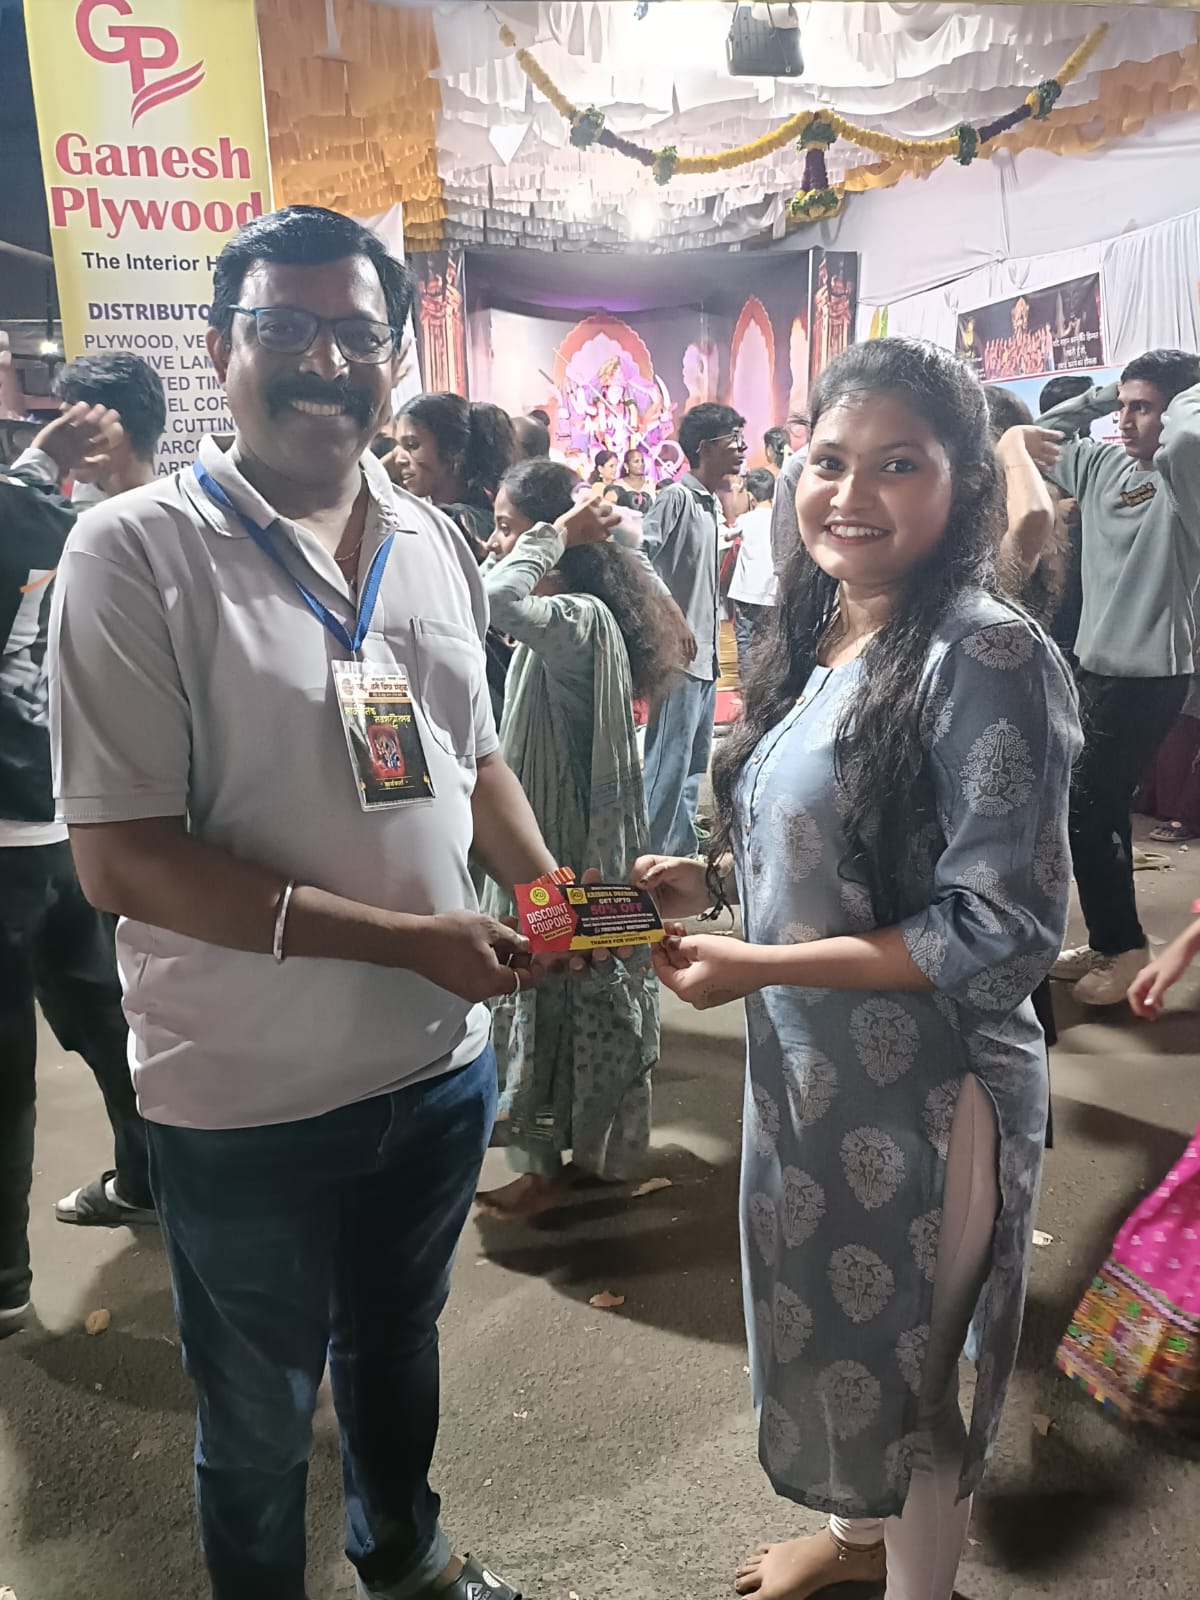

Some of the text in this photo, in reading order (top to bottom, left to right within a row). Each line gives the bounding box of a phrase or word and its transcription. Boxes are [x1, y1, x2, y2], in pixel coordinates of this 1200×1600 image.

[55, 132, 251, 179] Ganesh
[50, 187, 263, 239] Plywood
[81, 252, 120, 270] The
[126, 254, 200, 272] Interior
[88, 303, 209, 321] DISTRIBUTO
[84, 334, 179, 351] PLYWOOD,
[168, 397, 190, 412] EL
[172, 417, 235, 433] CUTTIN
[526, 902, 568, 924] DISCOUNT
[620, 902, 642, 912] OFF
[531, 913, 573, 935] COUPONS
